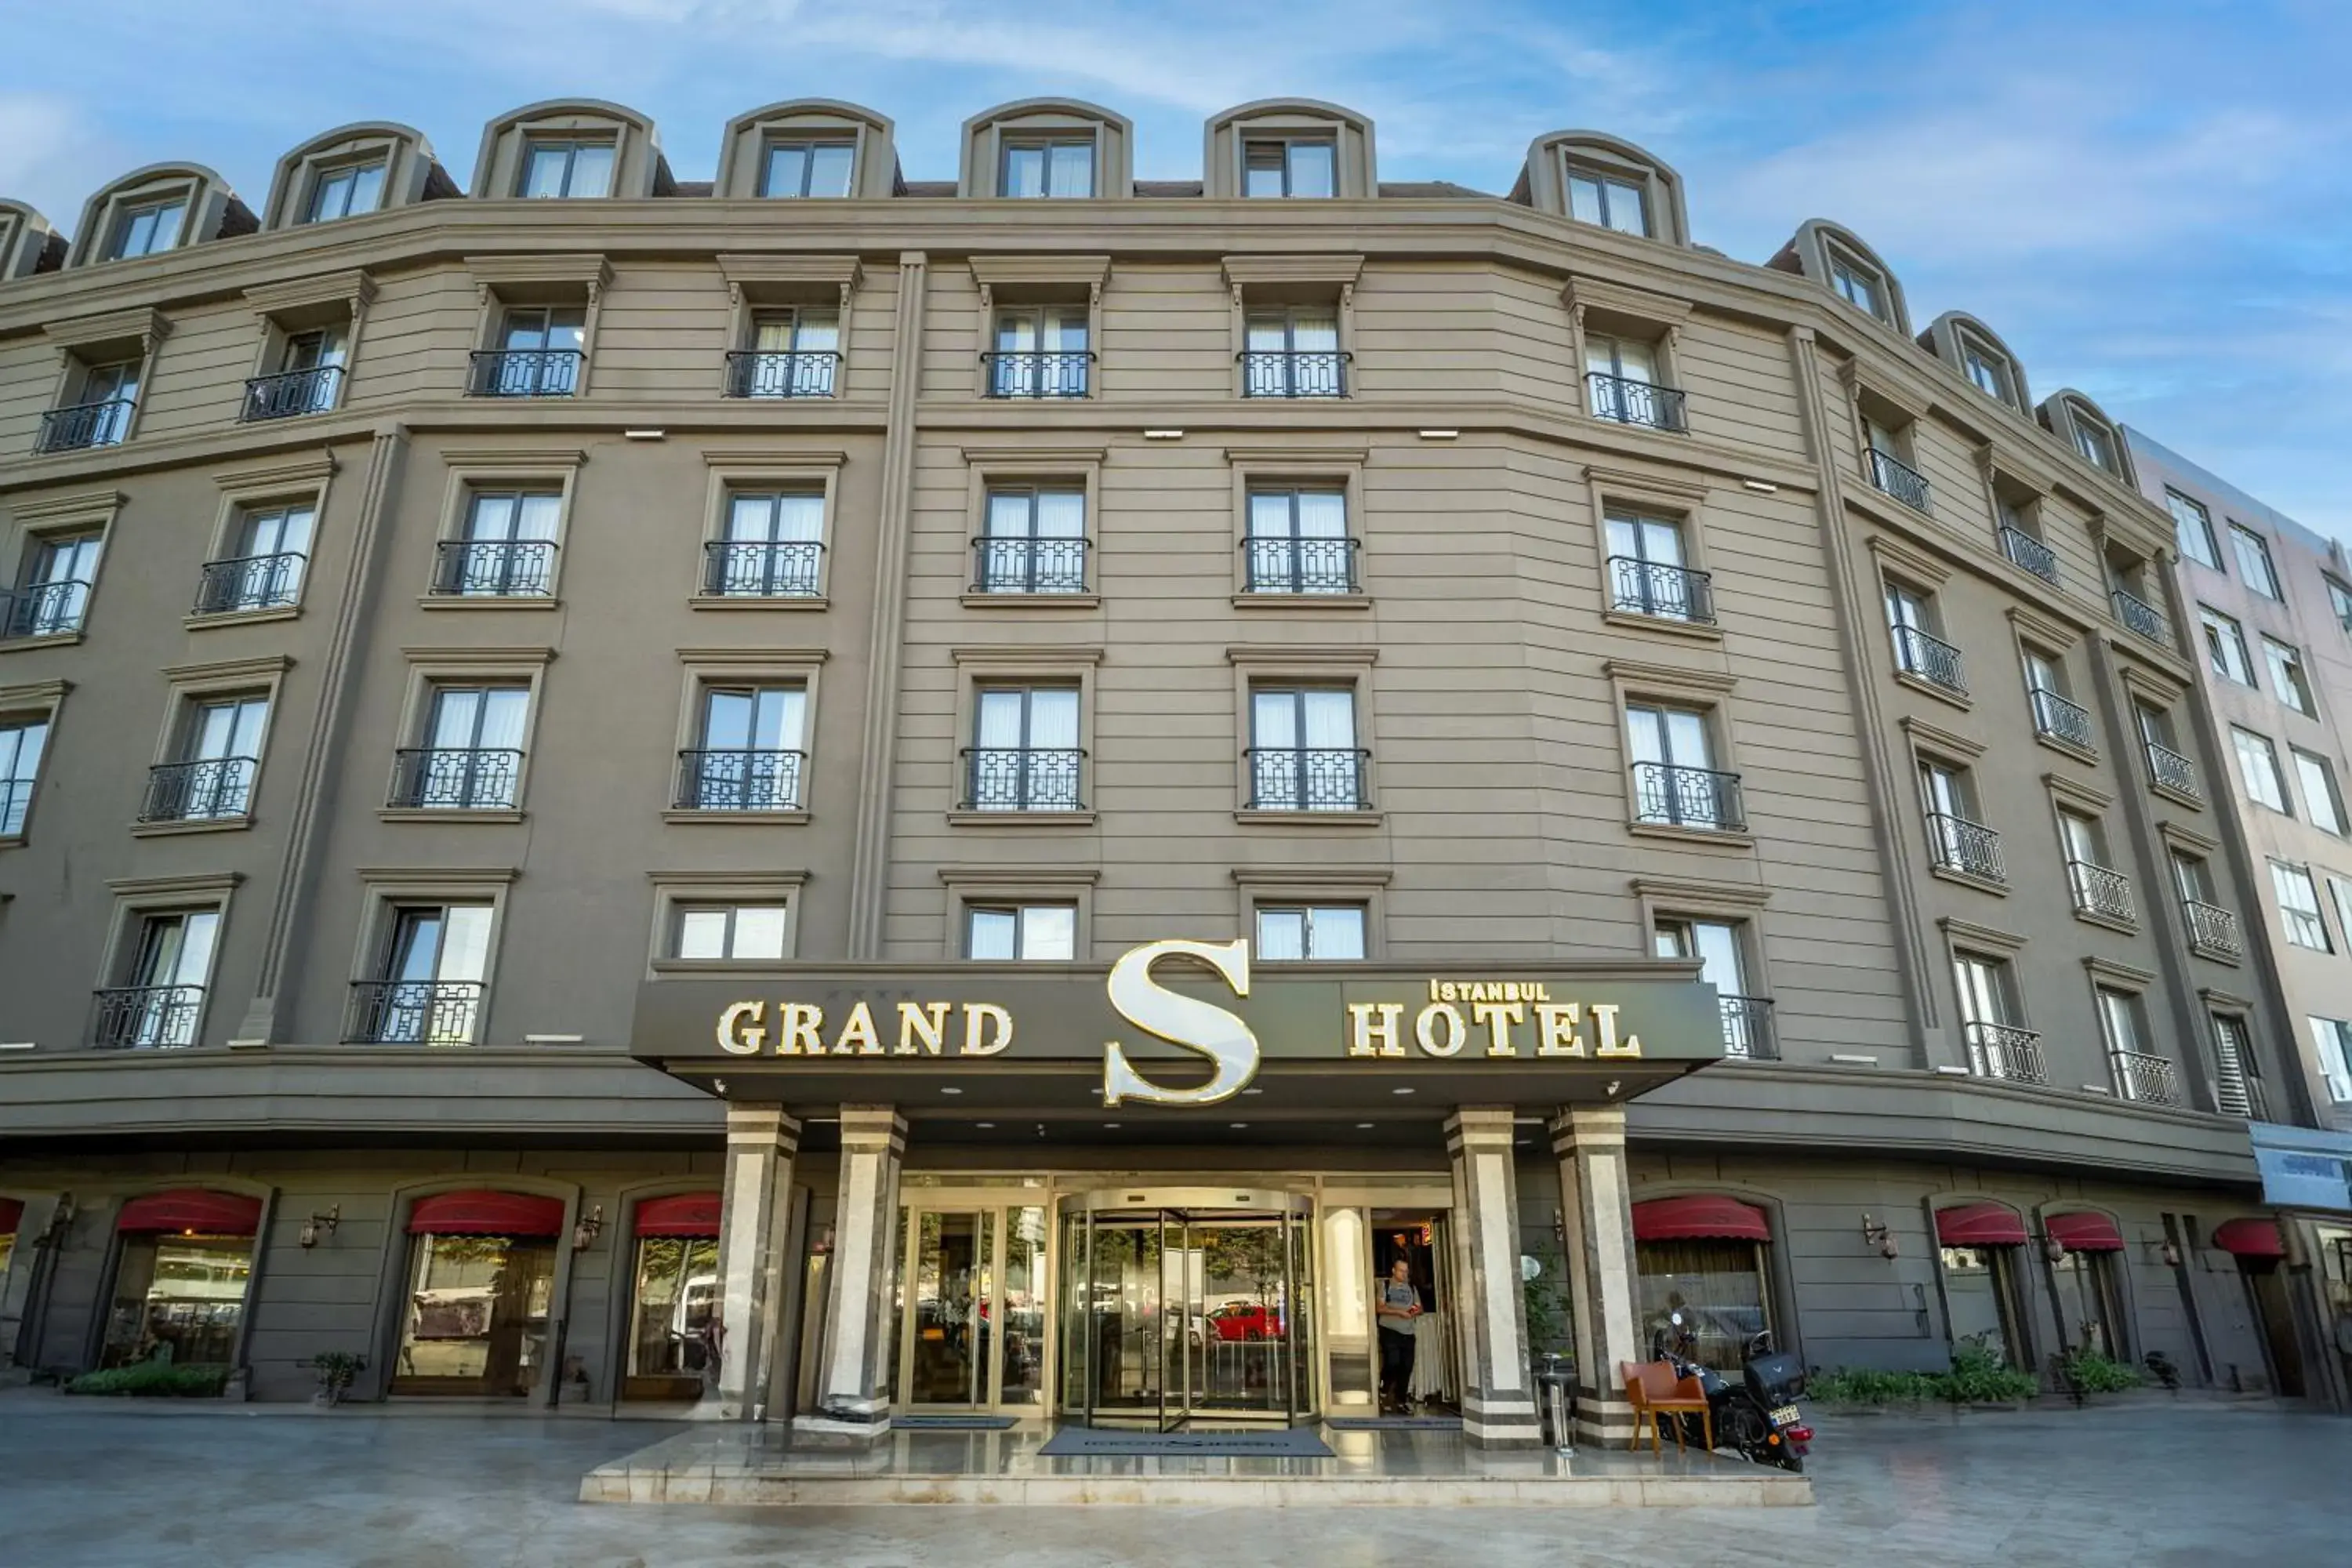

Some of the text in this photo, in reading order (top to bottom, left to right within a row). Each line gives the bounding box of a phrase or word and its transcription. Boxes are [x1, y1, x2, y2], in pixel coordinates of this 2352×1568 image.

[716, 939, 1641, 1106] GRAND S HOTEL
